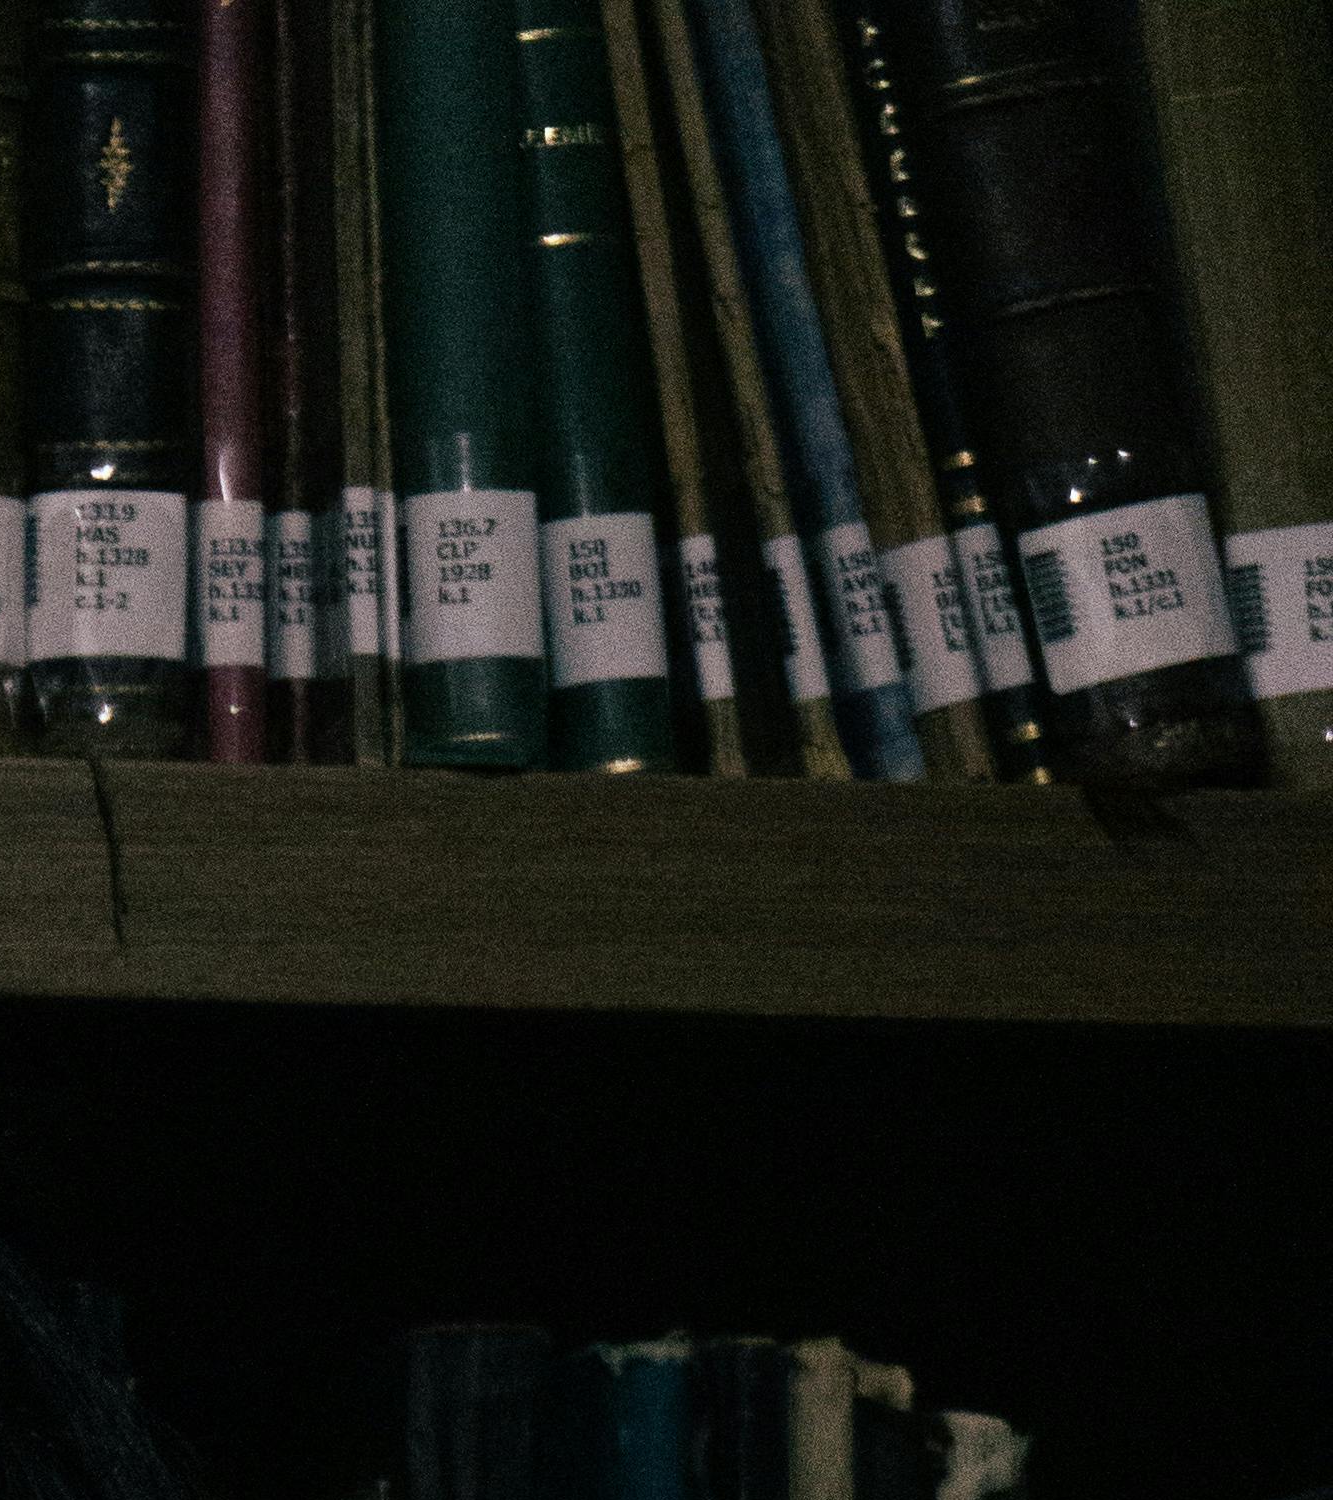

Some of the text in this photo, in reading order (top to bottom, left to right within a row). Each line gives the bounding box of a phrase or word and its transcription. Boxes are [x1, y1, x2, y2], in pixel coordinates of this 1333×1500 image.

[76, 526, 120, 543] HAS
[1099, 531, 1140, 557] 150
[76, 548, 149, 566] h.1328
[569, 539, 607, 559] 150
[439, 562, 492, 583] 1928
[1103, 552, 1149, 577] FON
[75, 571, 106, 587] k.1
[75, 592, 129, 610] c.1-2
[438, 585, 471, 605] k.1
[573, 607, 605, 625] k.1
